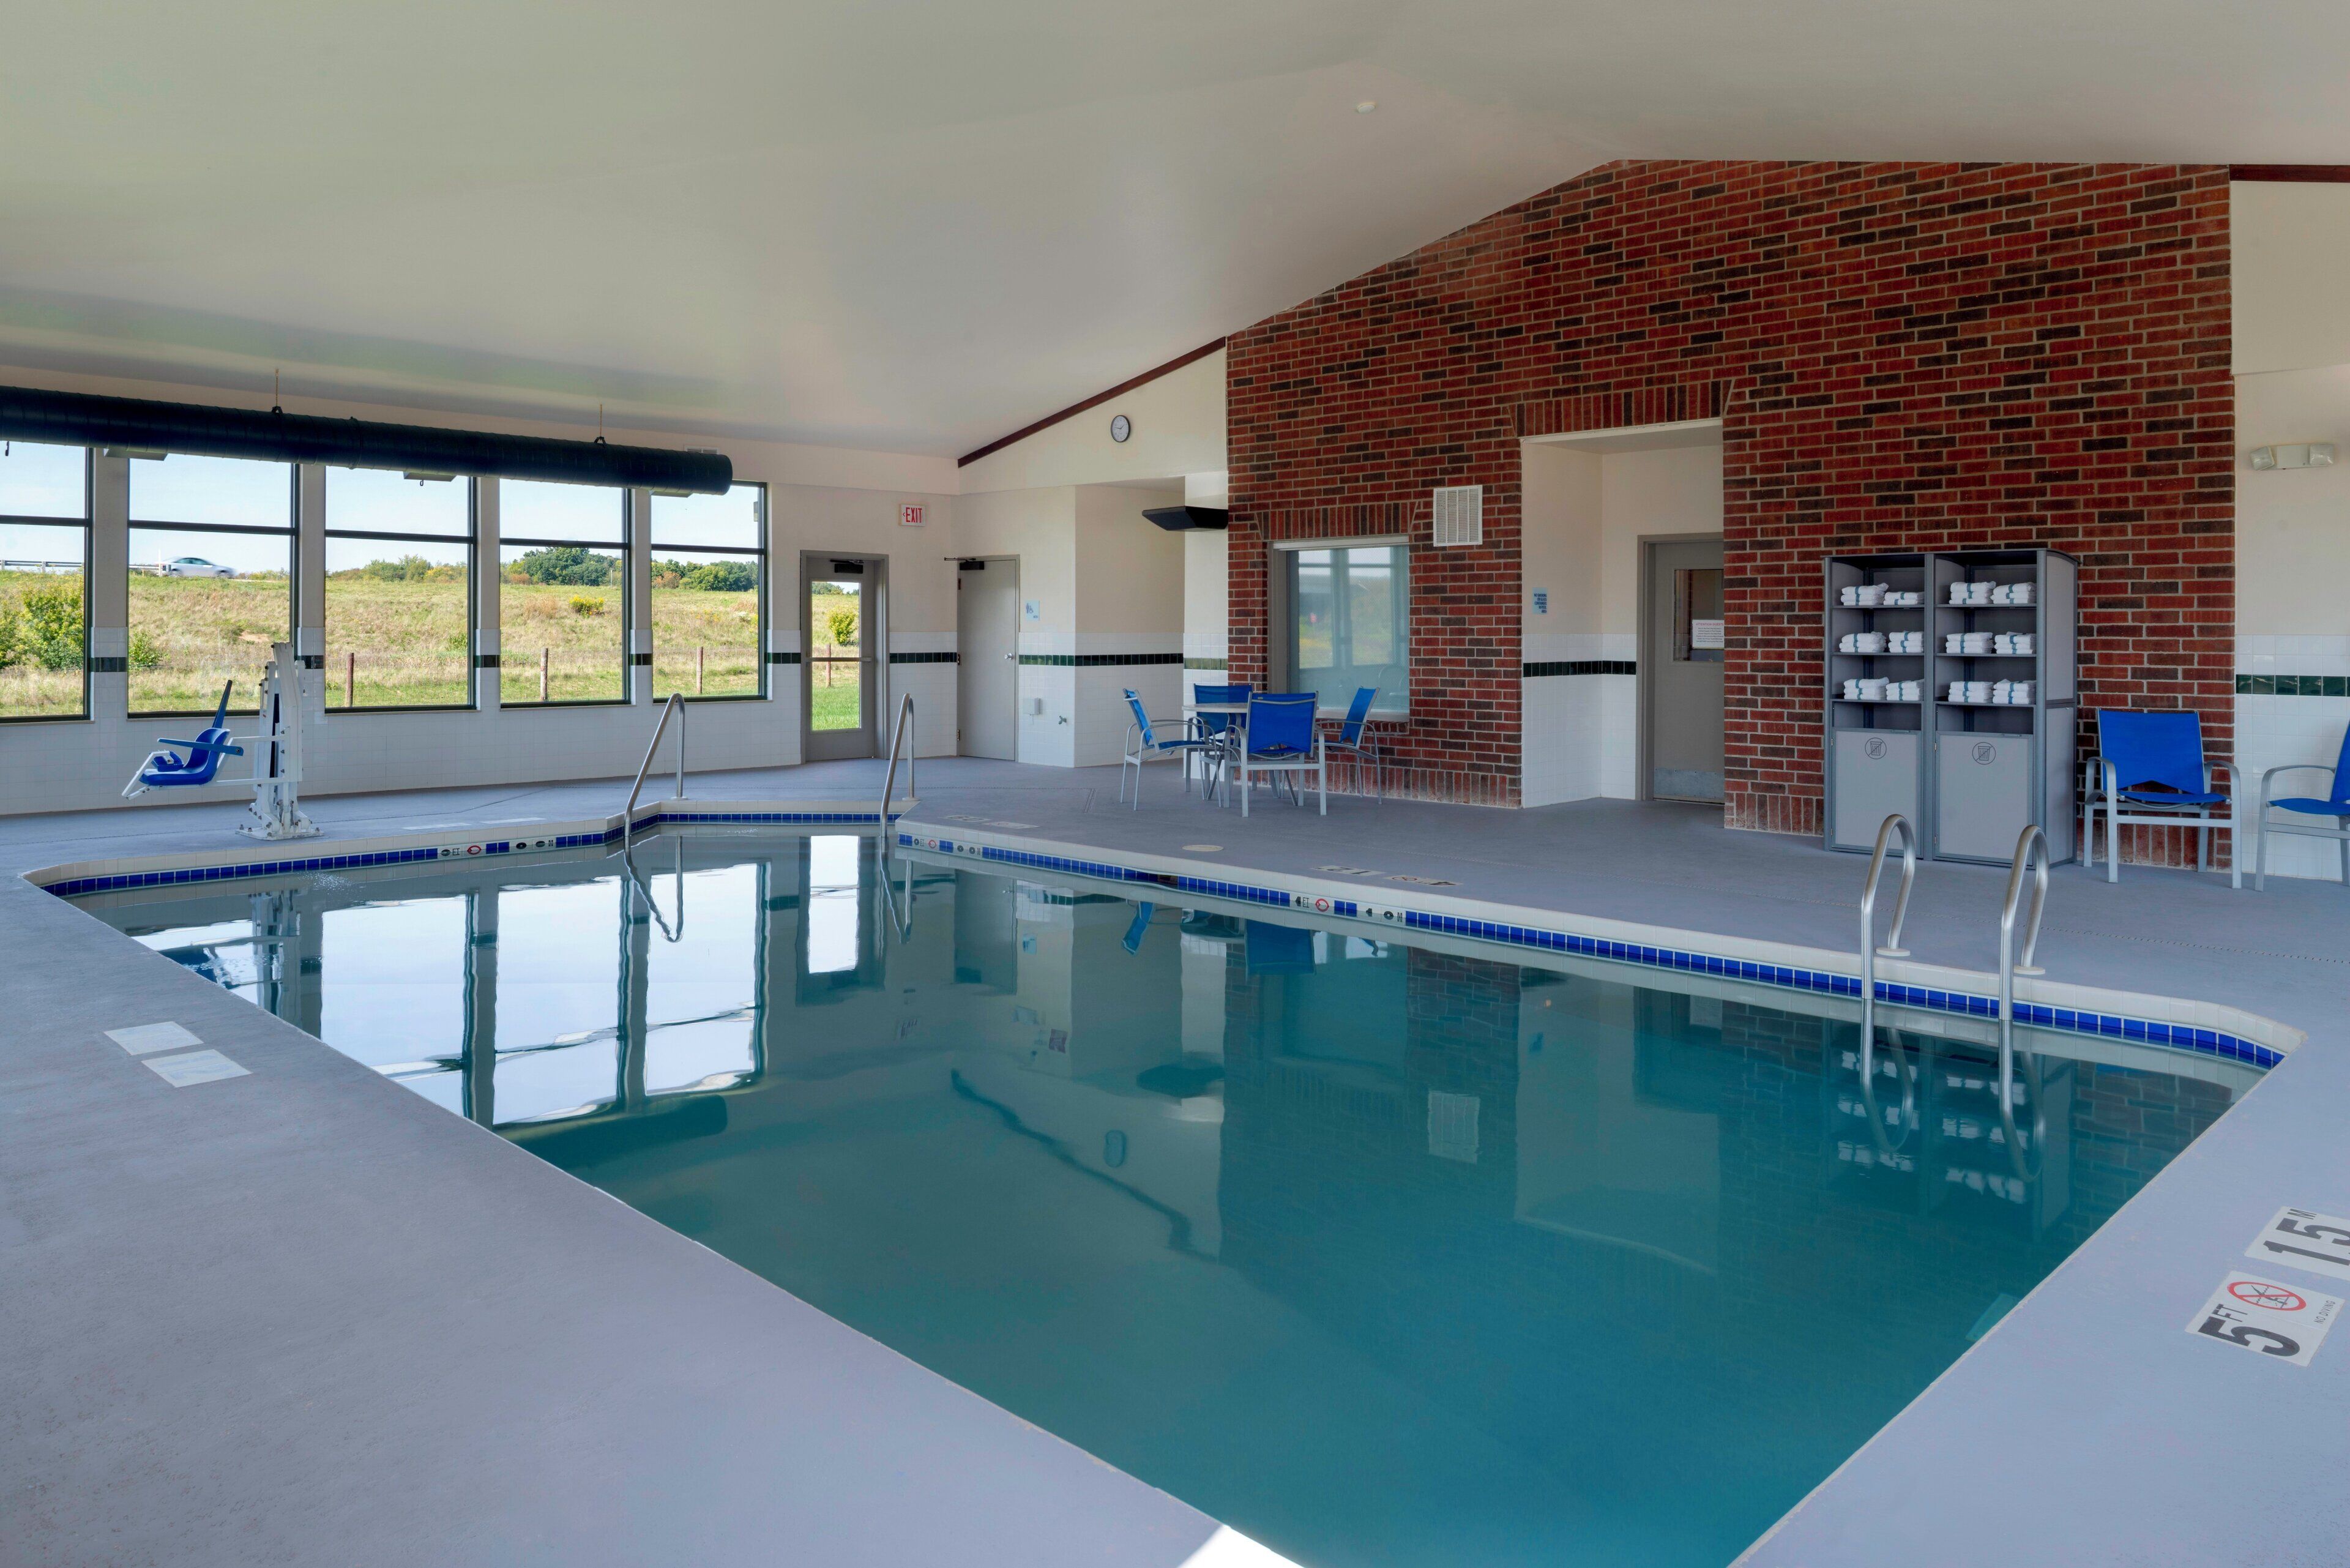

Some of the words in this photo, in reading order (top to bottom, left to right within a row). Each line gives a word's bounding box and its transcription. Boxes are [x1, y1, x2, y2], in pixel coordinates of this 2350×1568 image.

[906, 507, 922, 523] EXIT
[2212, 1303, 2248, 1323] FT
[2319, 1301, 2335, 1316] DIVING
[2313, 1316, 2326, 1324] NO
[2198, 1316, 2300, 1357] 5
